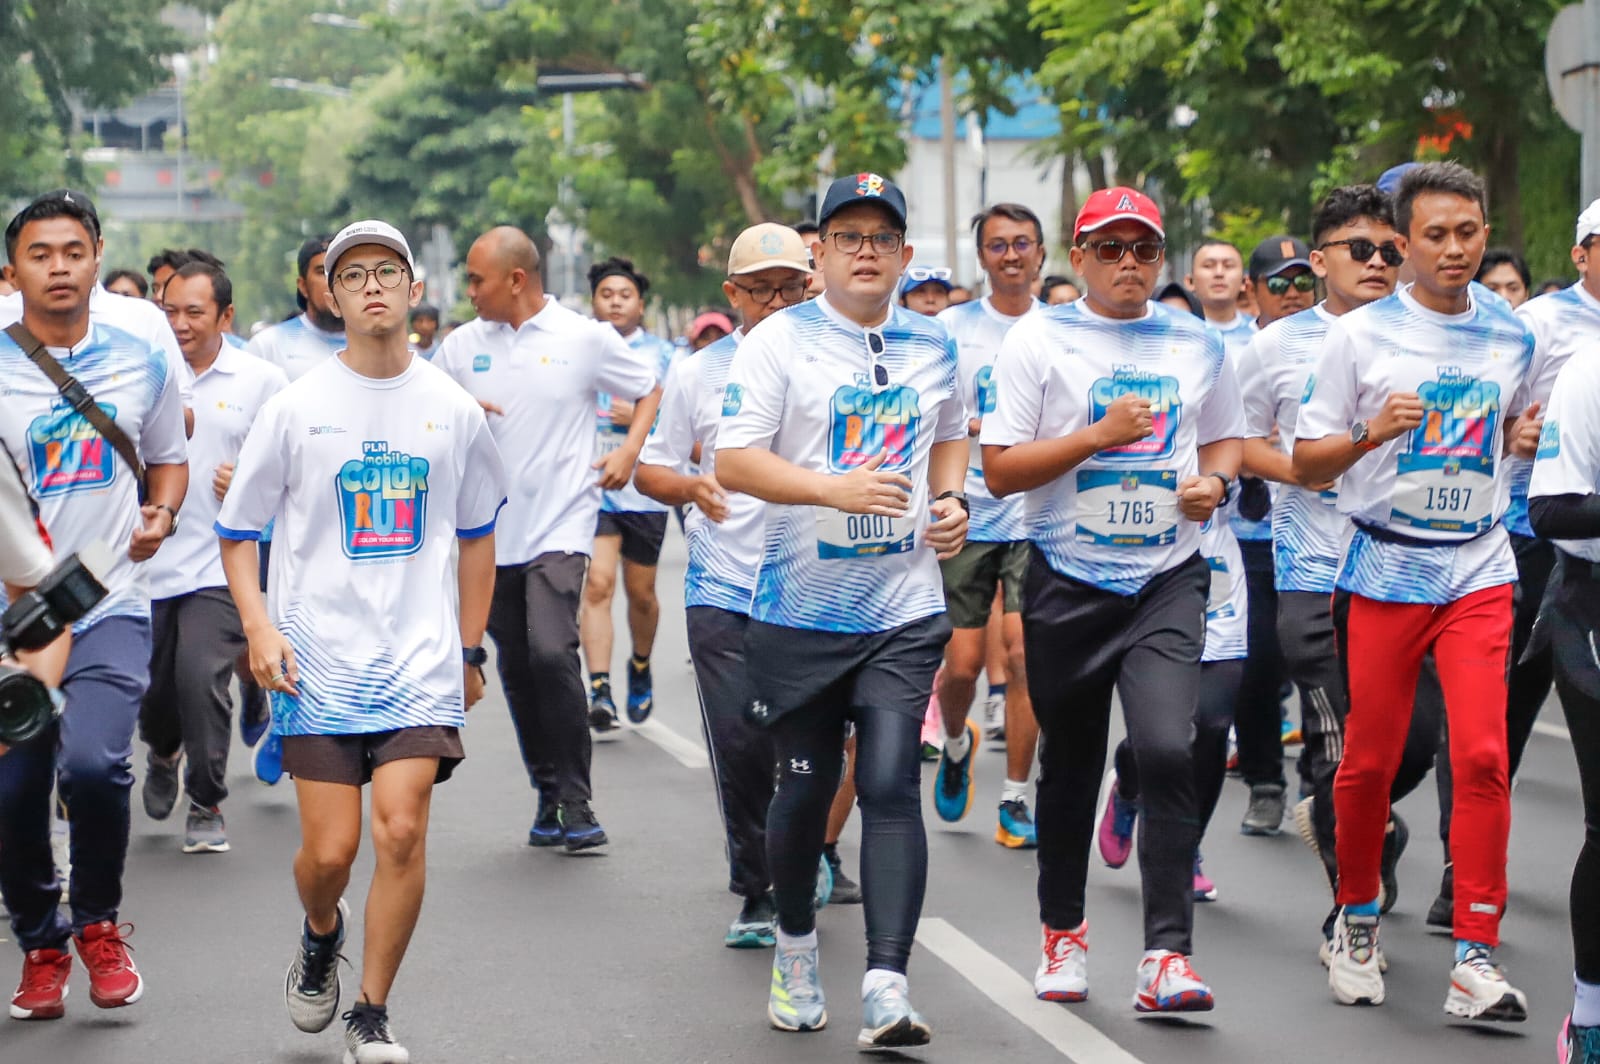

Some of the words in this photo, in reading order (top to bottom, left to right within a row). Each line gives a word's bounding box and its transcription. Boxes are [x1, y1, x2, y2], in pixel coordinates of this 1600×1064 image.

[1115, 194, 1138, 212] A
[834, 385, 919, 424] COLOR
[1418, 381, 1500, 418] COLOR
[364, 442, 387, 452] PLN
[845, 415, 906, 454] RUN
[1425, 411, 1485, 448] RUN
[46, 437, 102, 473] RUN
[365, 452, 410, 465] mobile
[341, 458, 427, 499] COLOR
[355, 492, 414, 537] RUN
[1107, 501, 1154, 524] 1765
[1424, 487, 1472, 512] 1597
[847, 513, 894, 540] 0001
